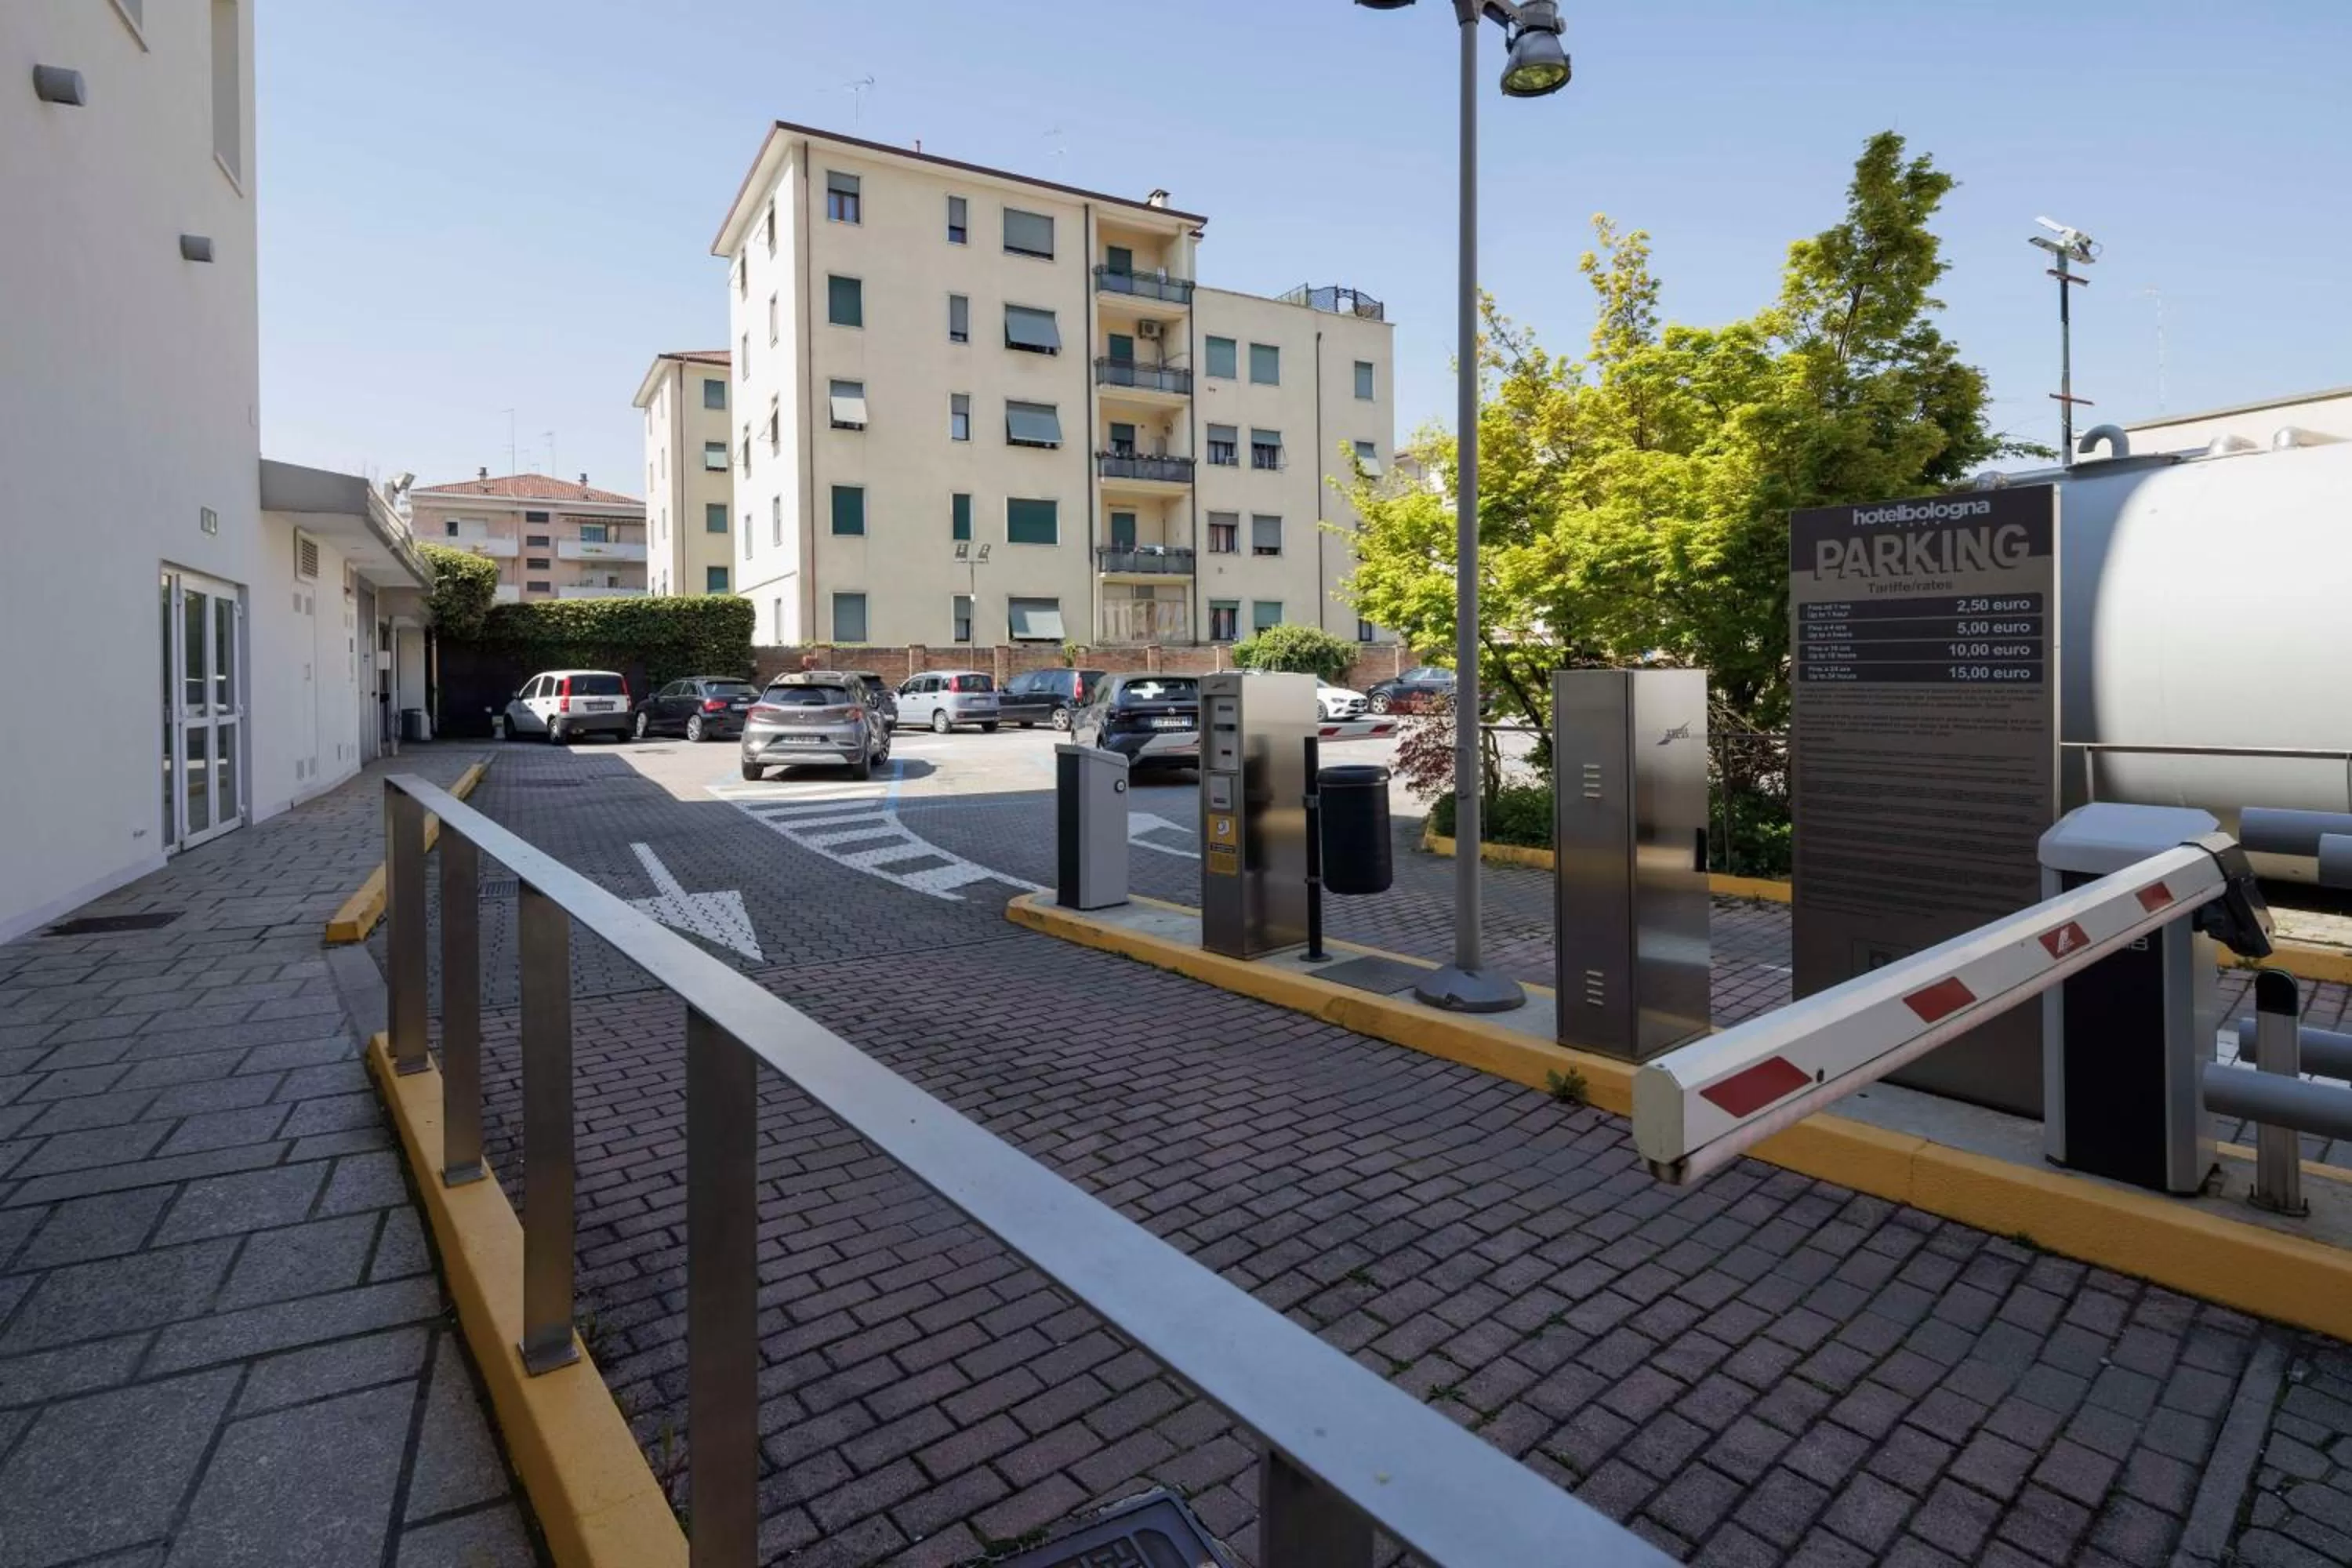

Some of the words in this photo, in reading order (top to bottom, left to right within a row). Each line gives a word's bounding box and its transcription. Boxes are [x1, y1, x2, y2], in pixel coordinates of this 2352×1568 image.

[1853, 500, 1991, 526] hotelbologna
[1814, 524, 2030, 580] PARKING
[1957, 599, 1989, 613] 2,50
[1993, 600, 2031, 611] euro
[1957, 621, 1989, 636] 5,00
[1993, 622, 2031, 633] euro
[1948, 644, 1989, 658] 10,00
[1993, 644, 2031, 656] euro
[1949, 666, 1989, 681] 15,00
[1993, 668, 2031, 679] euro
